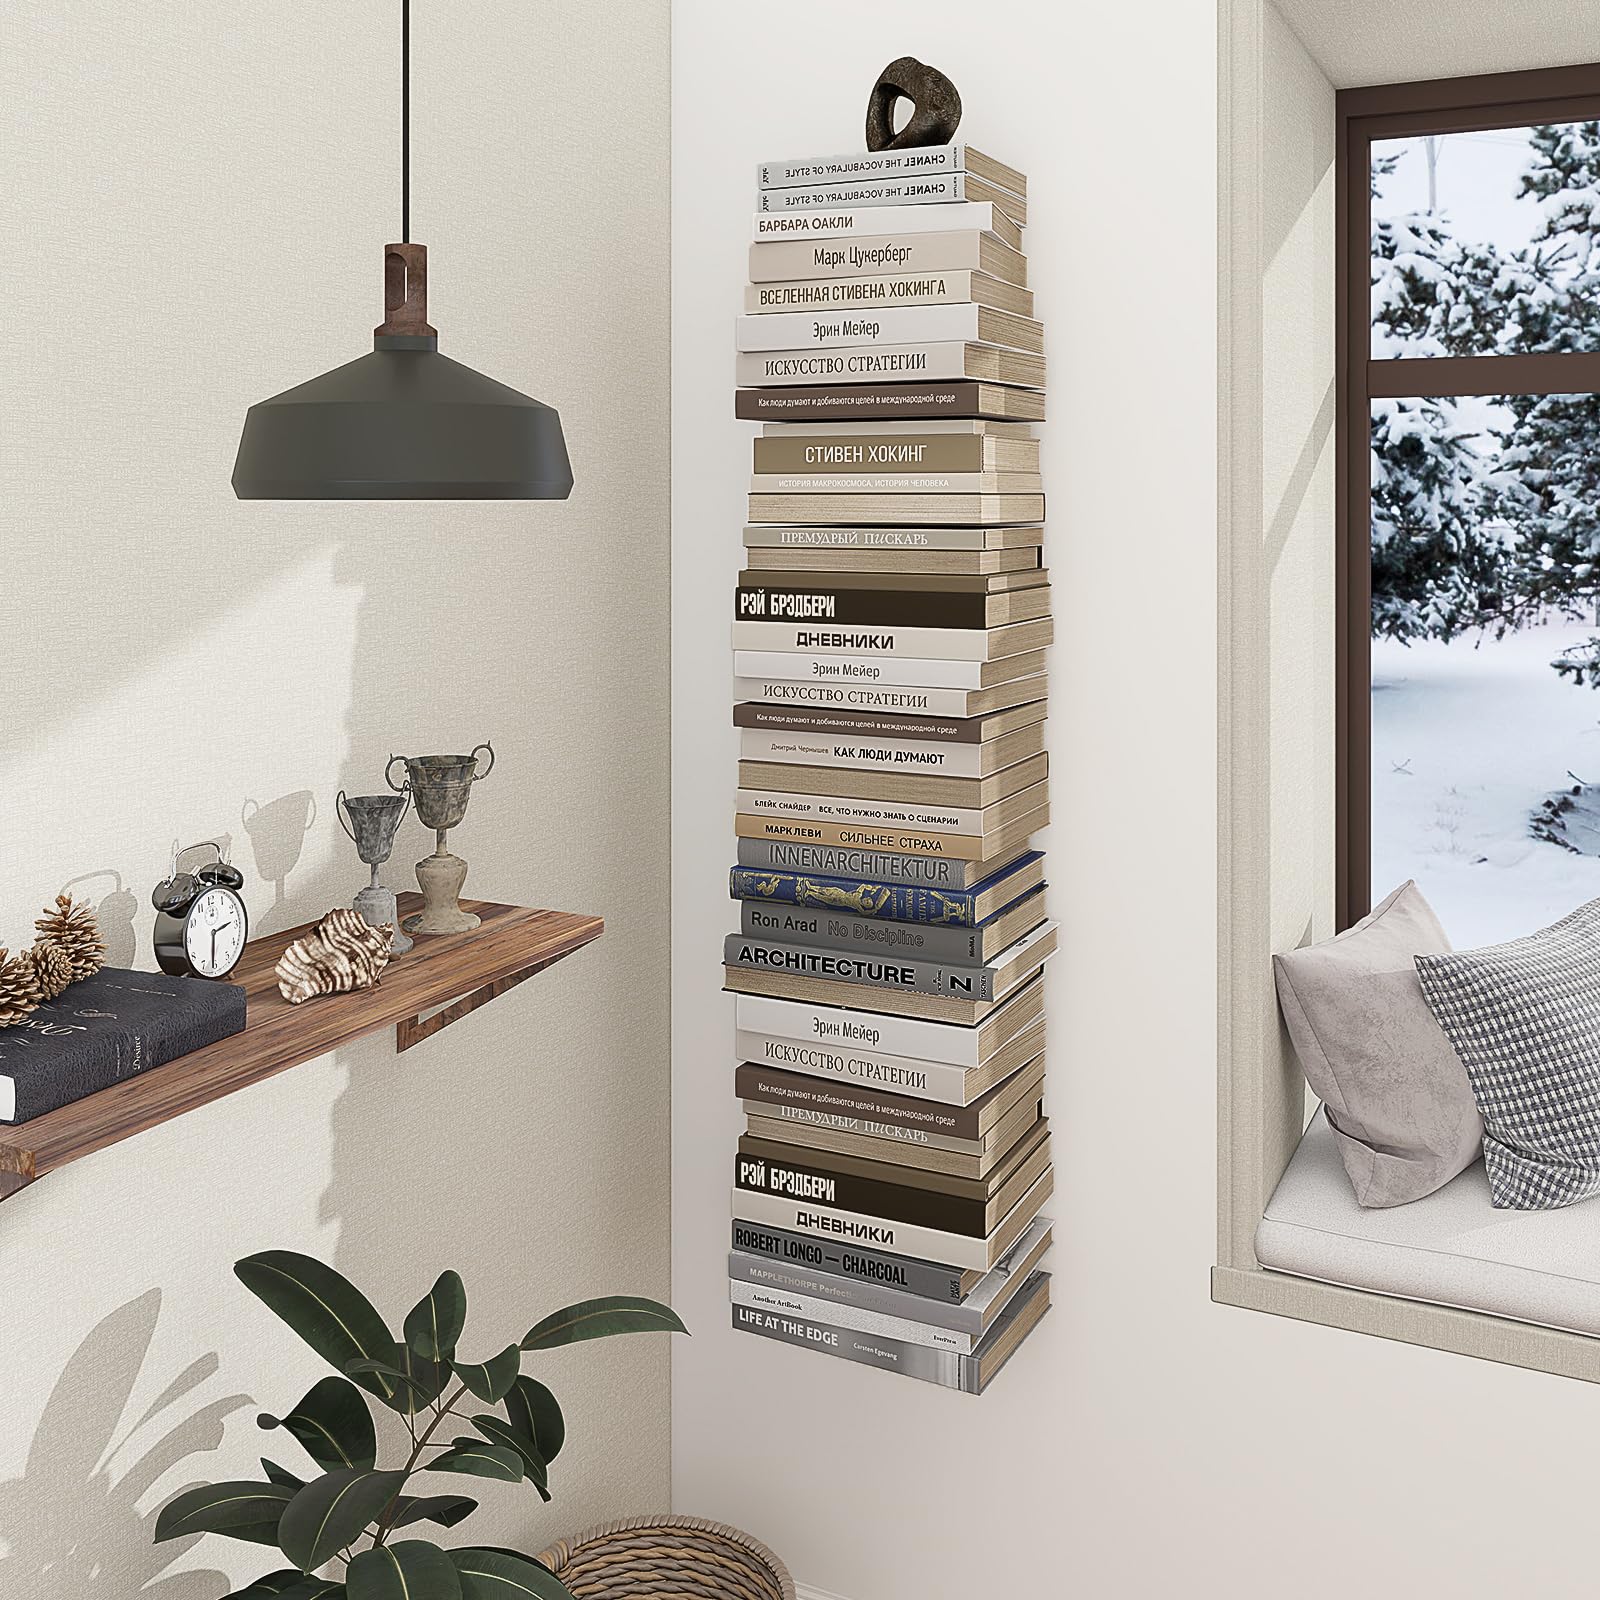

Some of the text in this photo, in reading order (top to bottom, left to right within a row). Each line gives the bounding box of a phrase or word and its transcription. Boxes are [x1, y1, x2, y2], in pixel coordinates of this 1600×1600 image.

[759, 216, 853, 233] БАРБАРА ОАКЛИ
[813, 243, 913, 269] Марк Цукерберг
[760, 279, 946, 305] ВСЕЛЕННАЯ СТИВЕНА ХОКИНГА
[813, 320, 880, 341] Эрин Мейер
[765, 353, 926, 376] ИСКУССТВО СТРАТЕГИИ
[758, 398, 769, 407] Как
[787, 398, 811, 408] думают
[817, 396, 854, 407] добиваются
[856, 395, 875, 405] целей
[881, 394, 934, 405] международной
[936, 394, 956, 404] среде
[805, 444, 927, 463] СТИВЕН ХОКИНГ
[778, 479, 811, 488] ИСТОРИЯ
[874, 479, 908, 488] ИСТОРИЯ
[910, 478, 949, 488] ЧЕЛОВЕКА
[781, 530, 859, 545] ПРЕМУДРЫЙ
[740, 589, 836, 618] РЭЙ БРЭДБЕРИ
[796, 631, 894, 650] ДНЕВНИКИ
[812, 662, 880, 680] Эрин Мейер
[764, 684, 928, 708] ИСКУССТВО СТРАТЕГИИ
[786, 716, 810, 724] думают
[816, 718, 854, 727] добиваются
[856, 721, 875, 729] целей
[882, 723, 936, 732] международной
[937, 726, 958, 734] среде
[770, 743, 796, 752] Дмитрий
[834, 746, 945, 765] КАК ЛЮДИ ДУМАЮТ
[754, 800, 811, 812] БЛЕЙК СНАЙДЕР
[819, 806, 834, 814] ВСЕ,
[852, 809, 881, 818] НУЖНО
[883, 812, 906, 821] ЗНАТЬ
[916, 815, 958, 825] СЦЕНАРИИ
[765, 825, 822, 838] МАРК ЛЕВИ
[840, 831, 942, 851] СИЛЬНЕЕ СТРАХА
[769, 844, 950, 882] INNENARCHITEKTUR
[208, 895, 214, 905] 12
[751, 911, 817, 933] Ron Arad
[828, 920, 925, 948] No Discipline
[738, 946, 916, 986] ARCHITECTURE
[813, 1016, 880, 1046] Эрин Мейер
[765, 1042, 926, 1090] ИСКУССТВО СТРАТЕГИИ
[758, 1082, 769, 1092] Как
[787, 1089, 810, 1100] думают
[817, 1094, 854, 1108] добиваются
[856, 1101, 874, 1112] целей
[881, 1106, 934, 1122] международной
[936, 1115, 956, 1126] среде
[740, 1160, 836, 1202] РЭЙ БРЭДБЕРИ
[796, 1211, 895, 1246] ДНЕВНИКИ
[736, 1228, 781, 1252] ROBERT
[783, 1240, 823, 1265] LONGO
[842, 1254, 908, 1286] CHARCOAL
[750, 1268, 818, 1292] MAPPLETHORPE
[752, 1294, 803, 1311] Another ArtBook
[739, 1308, 839, 1346] LIFE AT THE EDGE
[854, 1342, 898, 1361] Carsten Egevang
